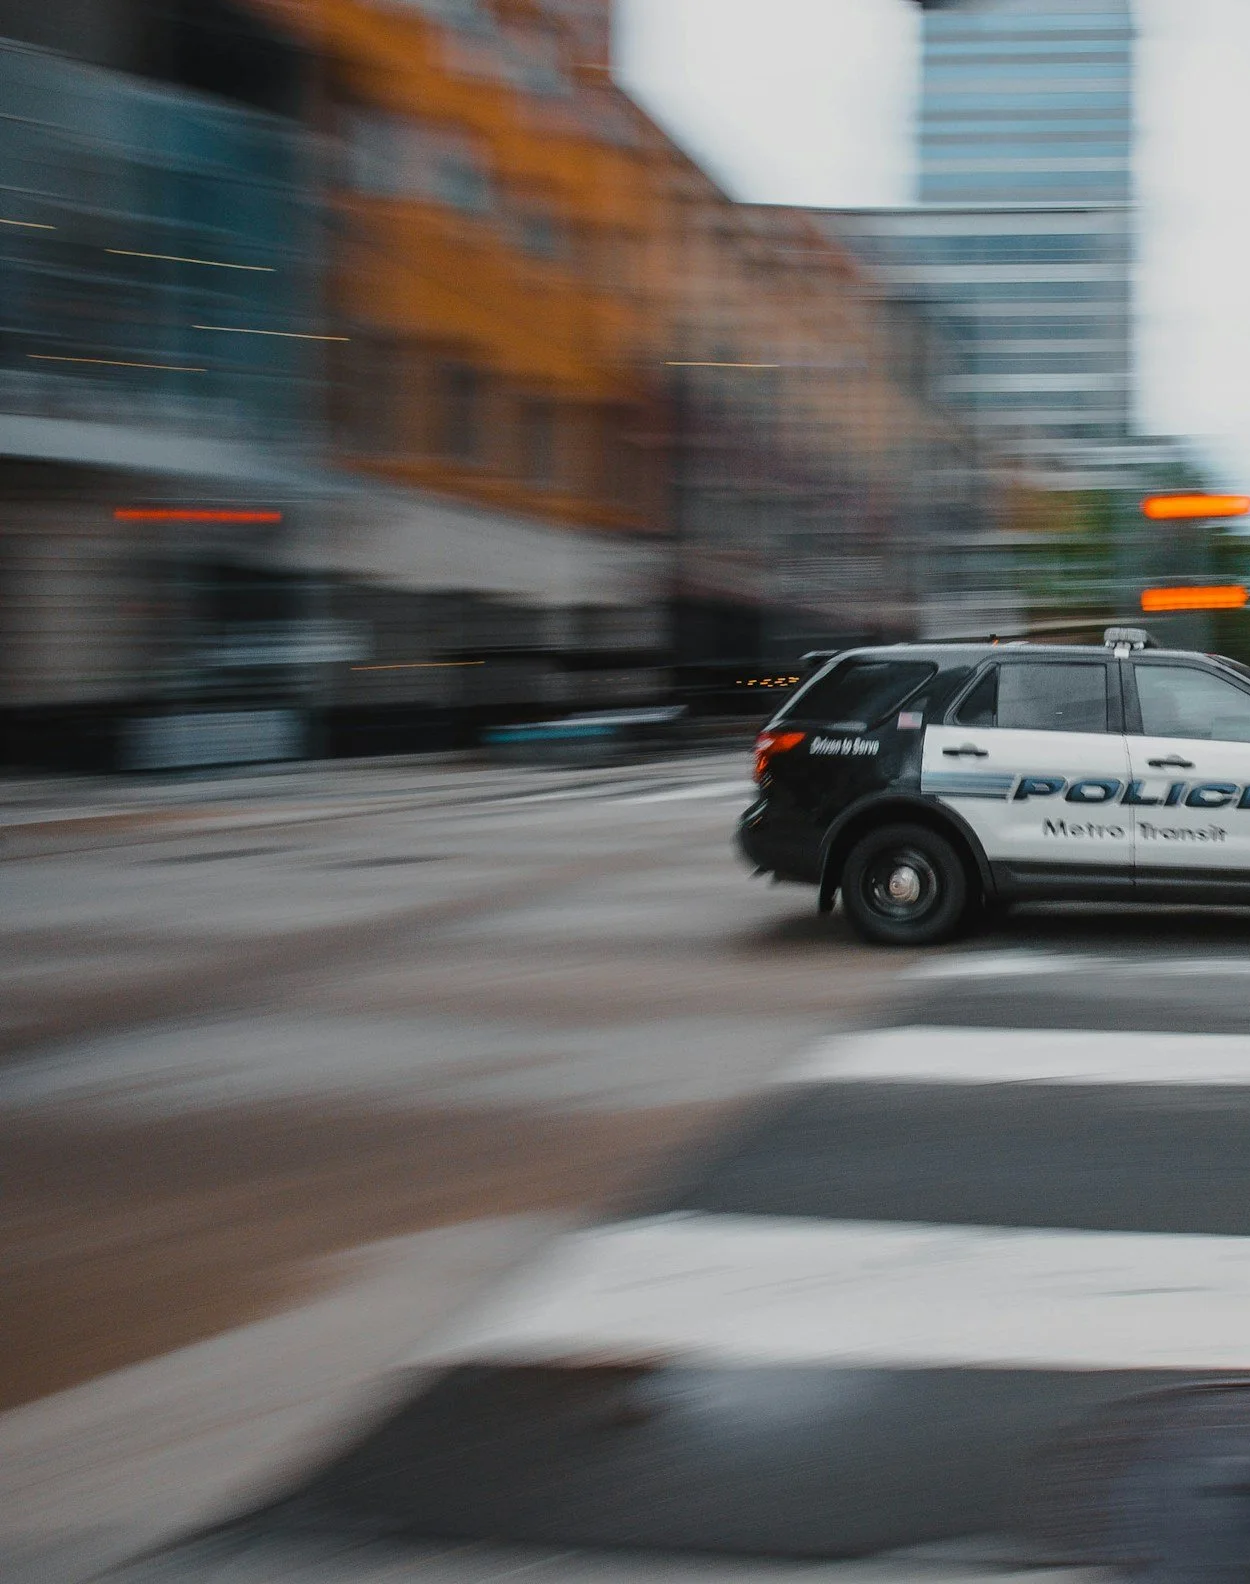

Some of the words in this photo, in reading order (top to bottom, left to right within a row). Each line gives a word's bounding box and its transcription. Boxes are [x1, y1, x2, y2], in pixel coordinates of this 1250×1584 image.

[809, 736, 842, 755] Driven
[841, 737, 853, 755] to
[1042, 817, 1126, 841] Metro
[1136, 820, 1229, 843] Transit
